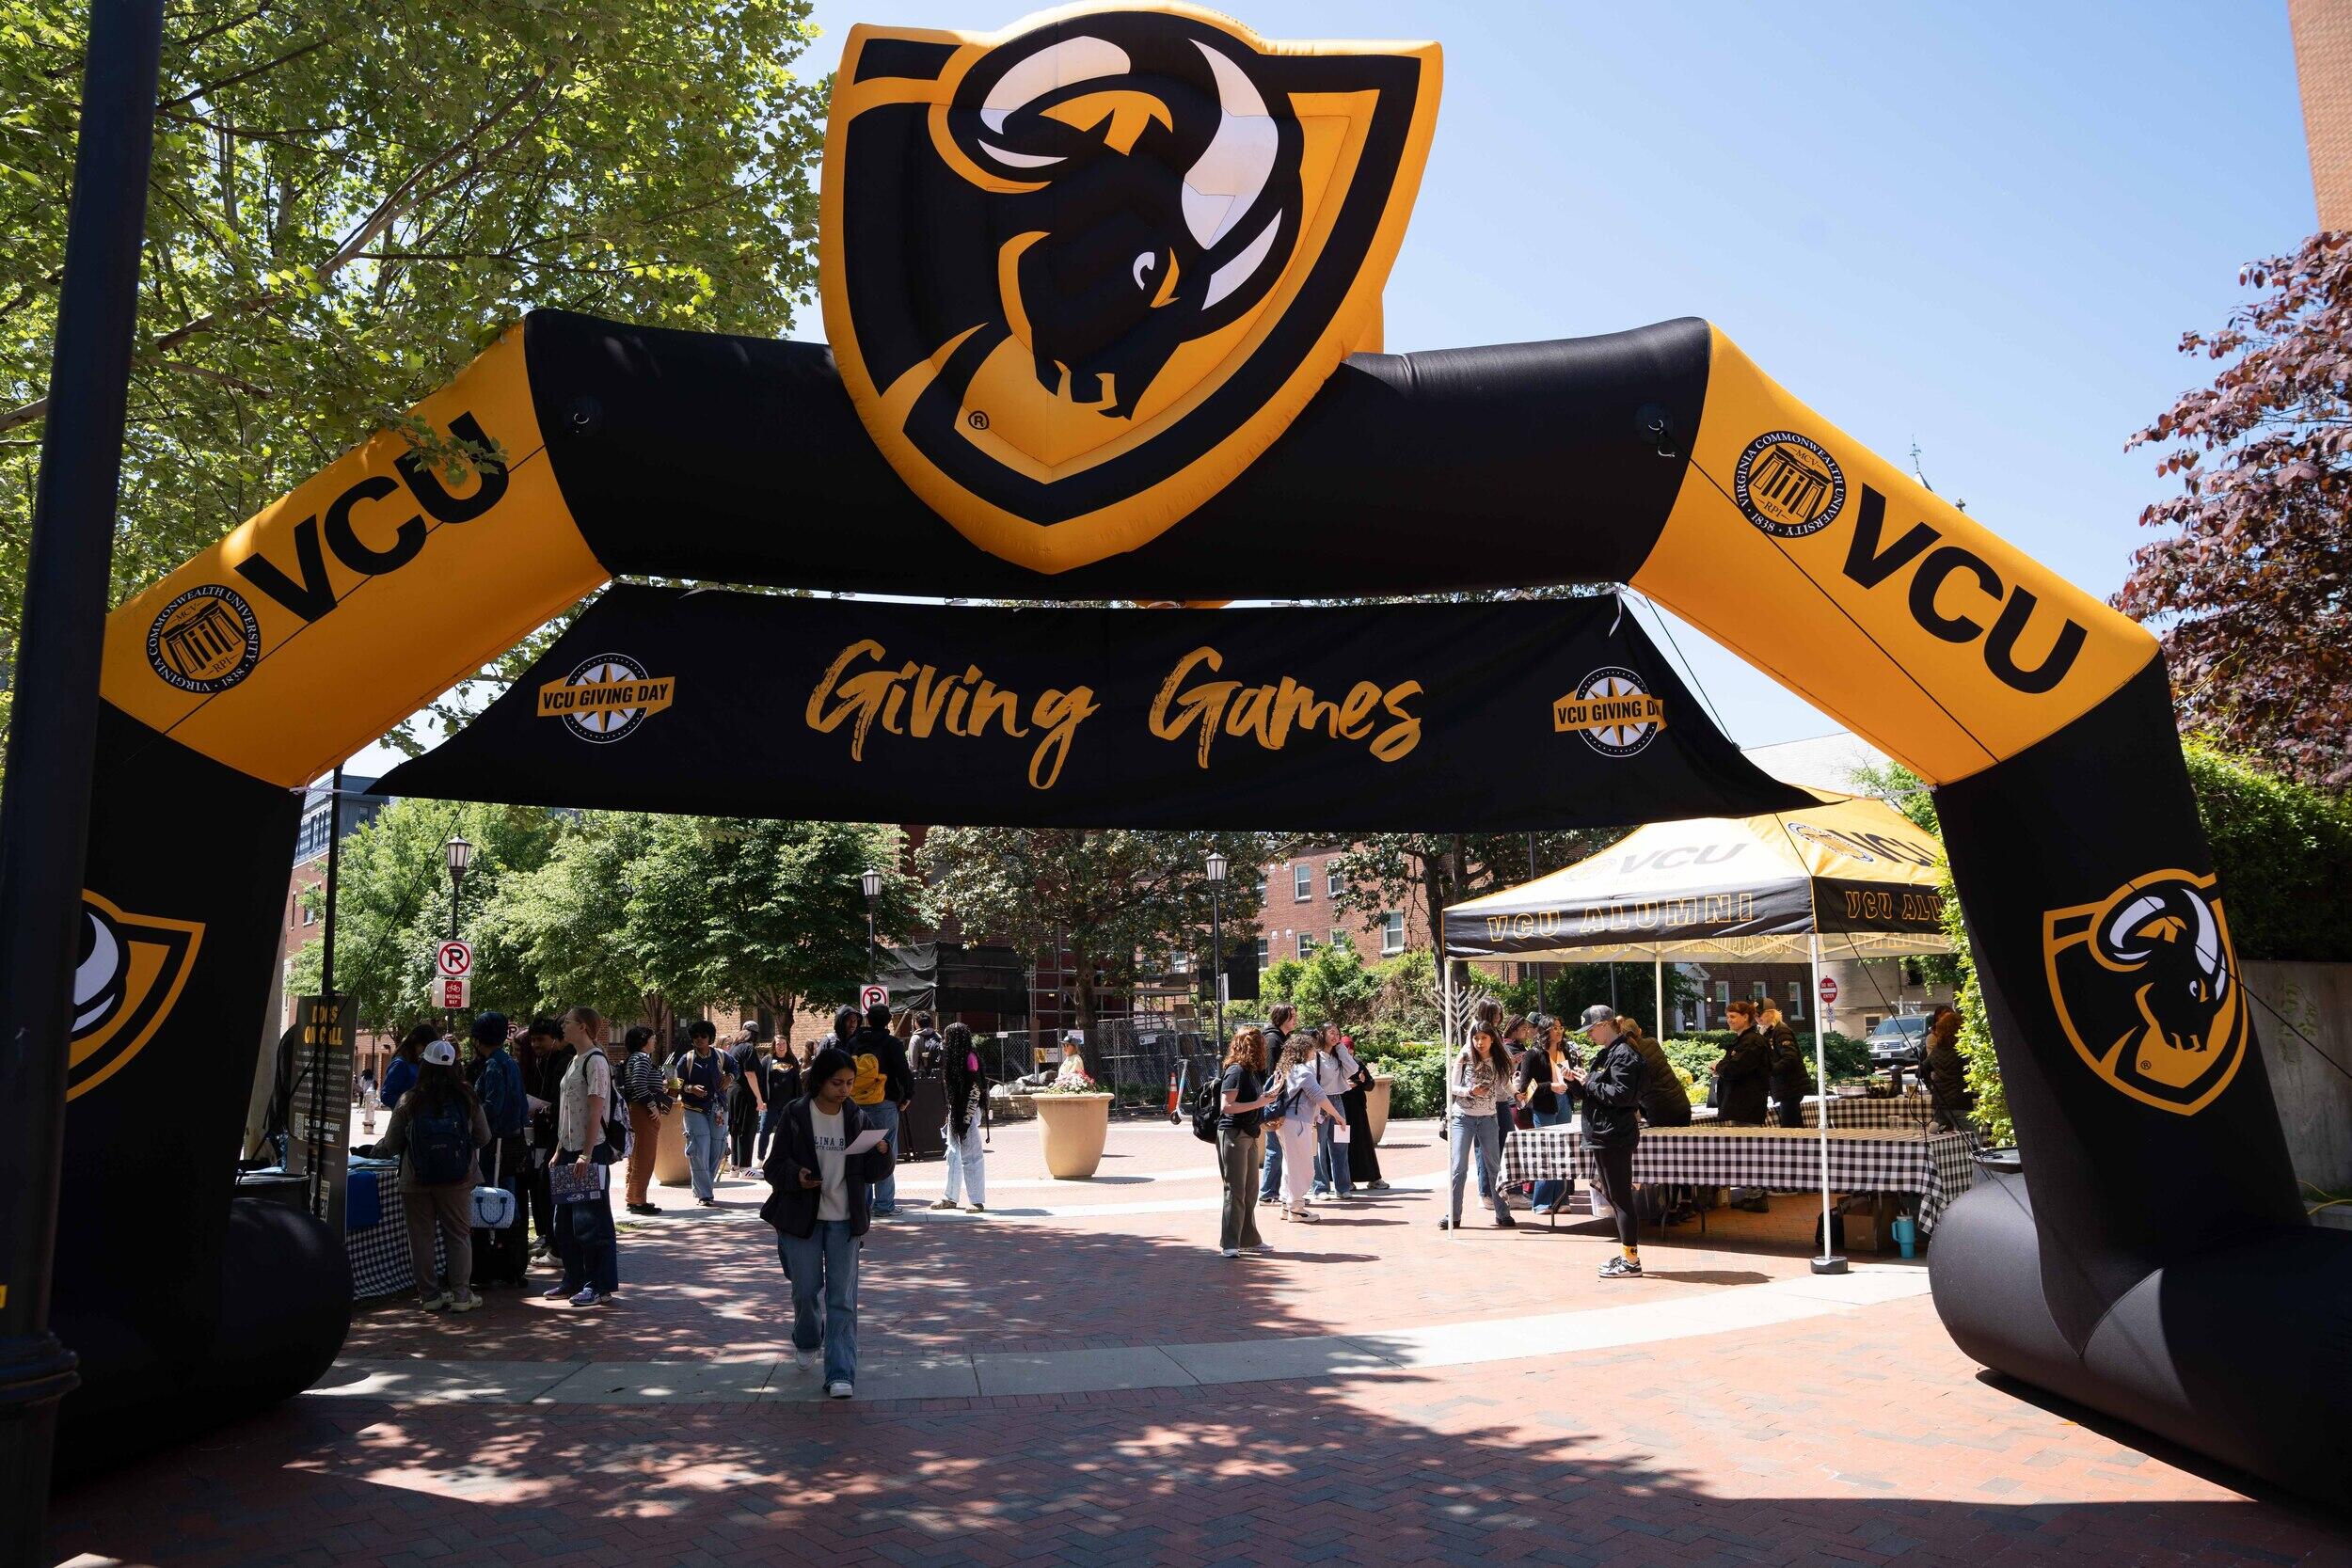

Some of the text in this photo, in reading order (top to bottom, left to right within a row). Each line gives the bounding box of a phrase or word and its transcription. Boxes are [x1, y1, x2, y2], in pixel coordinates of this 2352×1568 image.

[1796, 450, 1818, 466] MCV
[1736, 433, 1844, 536] VIRGINIA COMMONWEALTH UNIVERSITY 1838
[233, 410, 509, 624] VCU
[1764, 501, 1783, 517] RPI
[1842, 482, 2088, 693] VCU
[175, 603, 198, 622] MCV
[149, 587, 259, 691] VIRGINIA COMMONWEALTH UNIVERSITY 1838
[213, 657, 232, 673] RPI
[544, 683, 669, 709] VCU GIVING DAY
[805, 639, 1423, 790] Giving Games
[1557, 705, 1587, 724] VCU
[1592, 700, 1642, 721] GIVING
[1619, 843, 1749, 874] VCU
[1486, 894, 1753, 942] VCU ALUMNI
[1845, 891, 1892, 919] VCU
